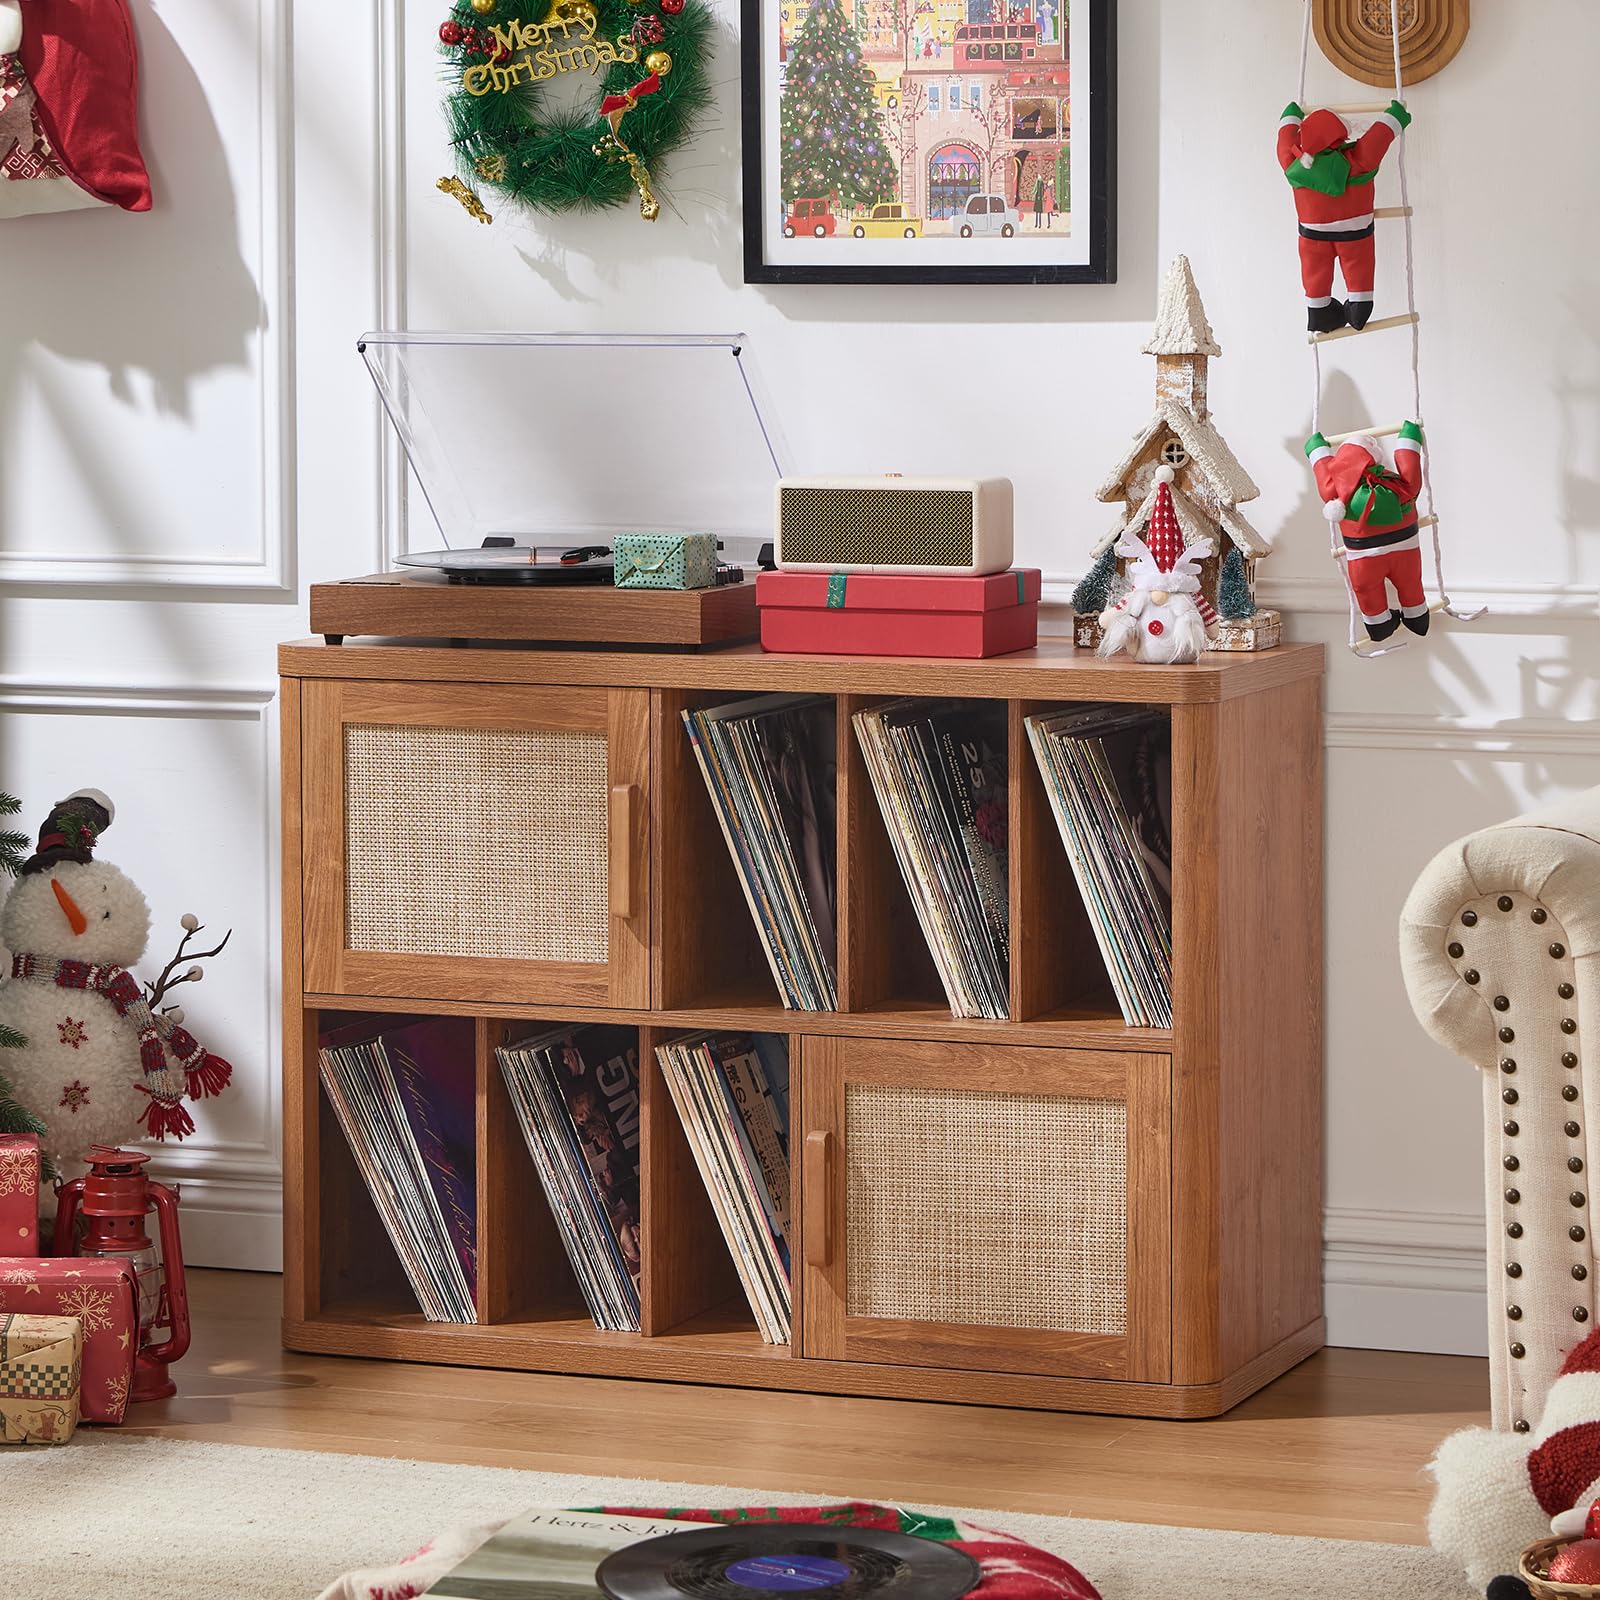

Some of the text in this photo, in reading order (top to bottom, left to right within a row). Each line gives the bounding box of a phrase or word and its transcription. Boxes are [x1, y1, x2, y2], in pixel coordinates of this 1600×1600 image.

[487, 13, 598, 58] Merry
[463, 35, 639, 97] Christmas
[531, 1515, 603, 1531] Hertz
[609, 1523, 635, 1534] &
